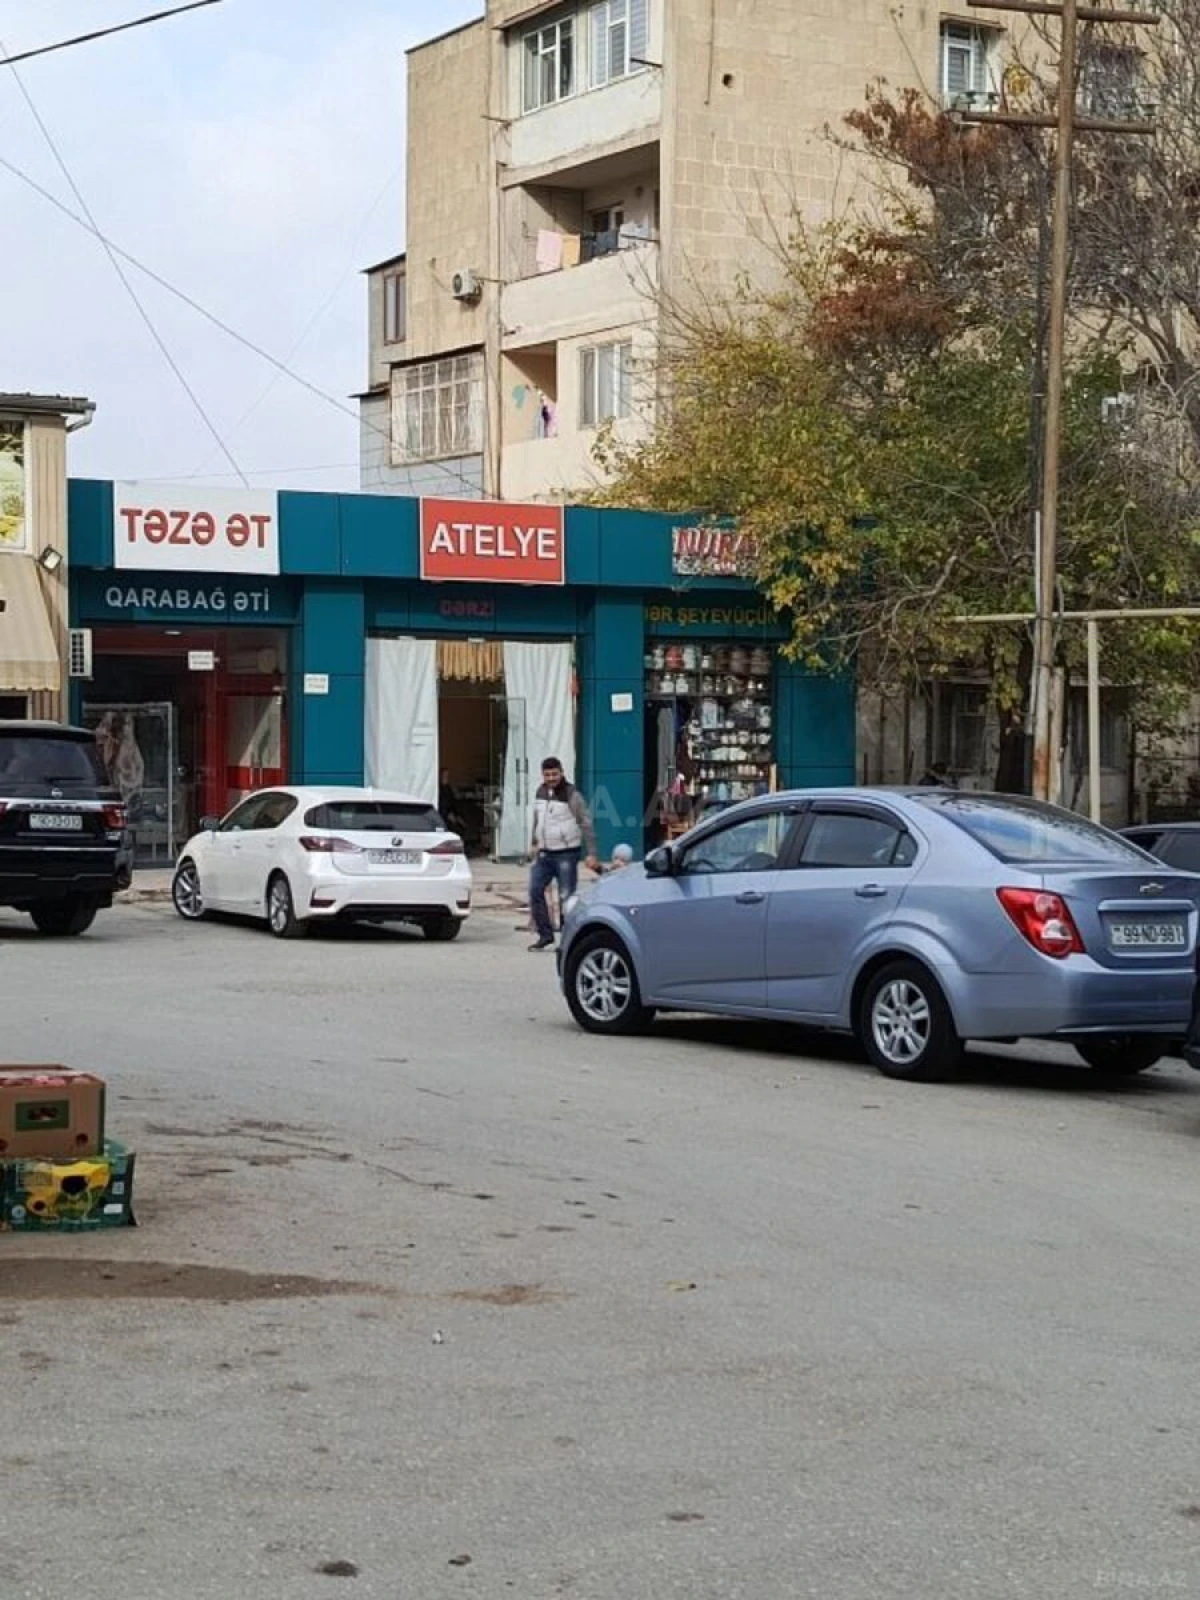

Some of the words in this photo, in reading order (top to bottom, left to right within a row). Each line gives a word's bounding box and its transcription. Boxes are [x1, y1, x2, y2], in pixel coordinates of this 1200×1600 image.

[120, 508, 216, 546] TƏZƏ
[226, 513, 271, 548] ƏT
[429, 522, 557, 559] ATELYE
[106, 587, 226, 611] QARABAĞ
[233, 588, 270, 612] ƏTİ
